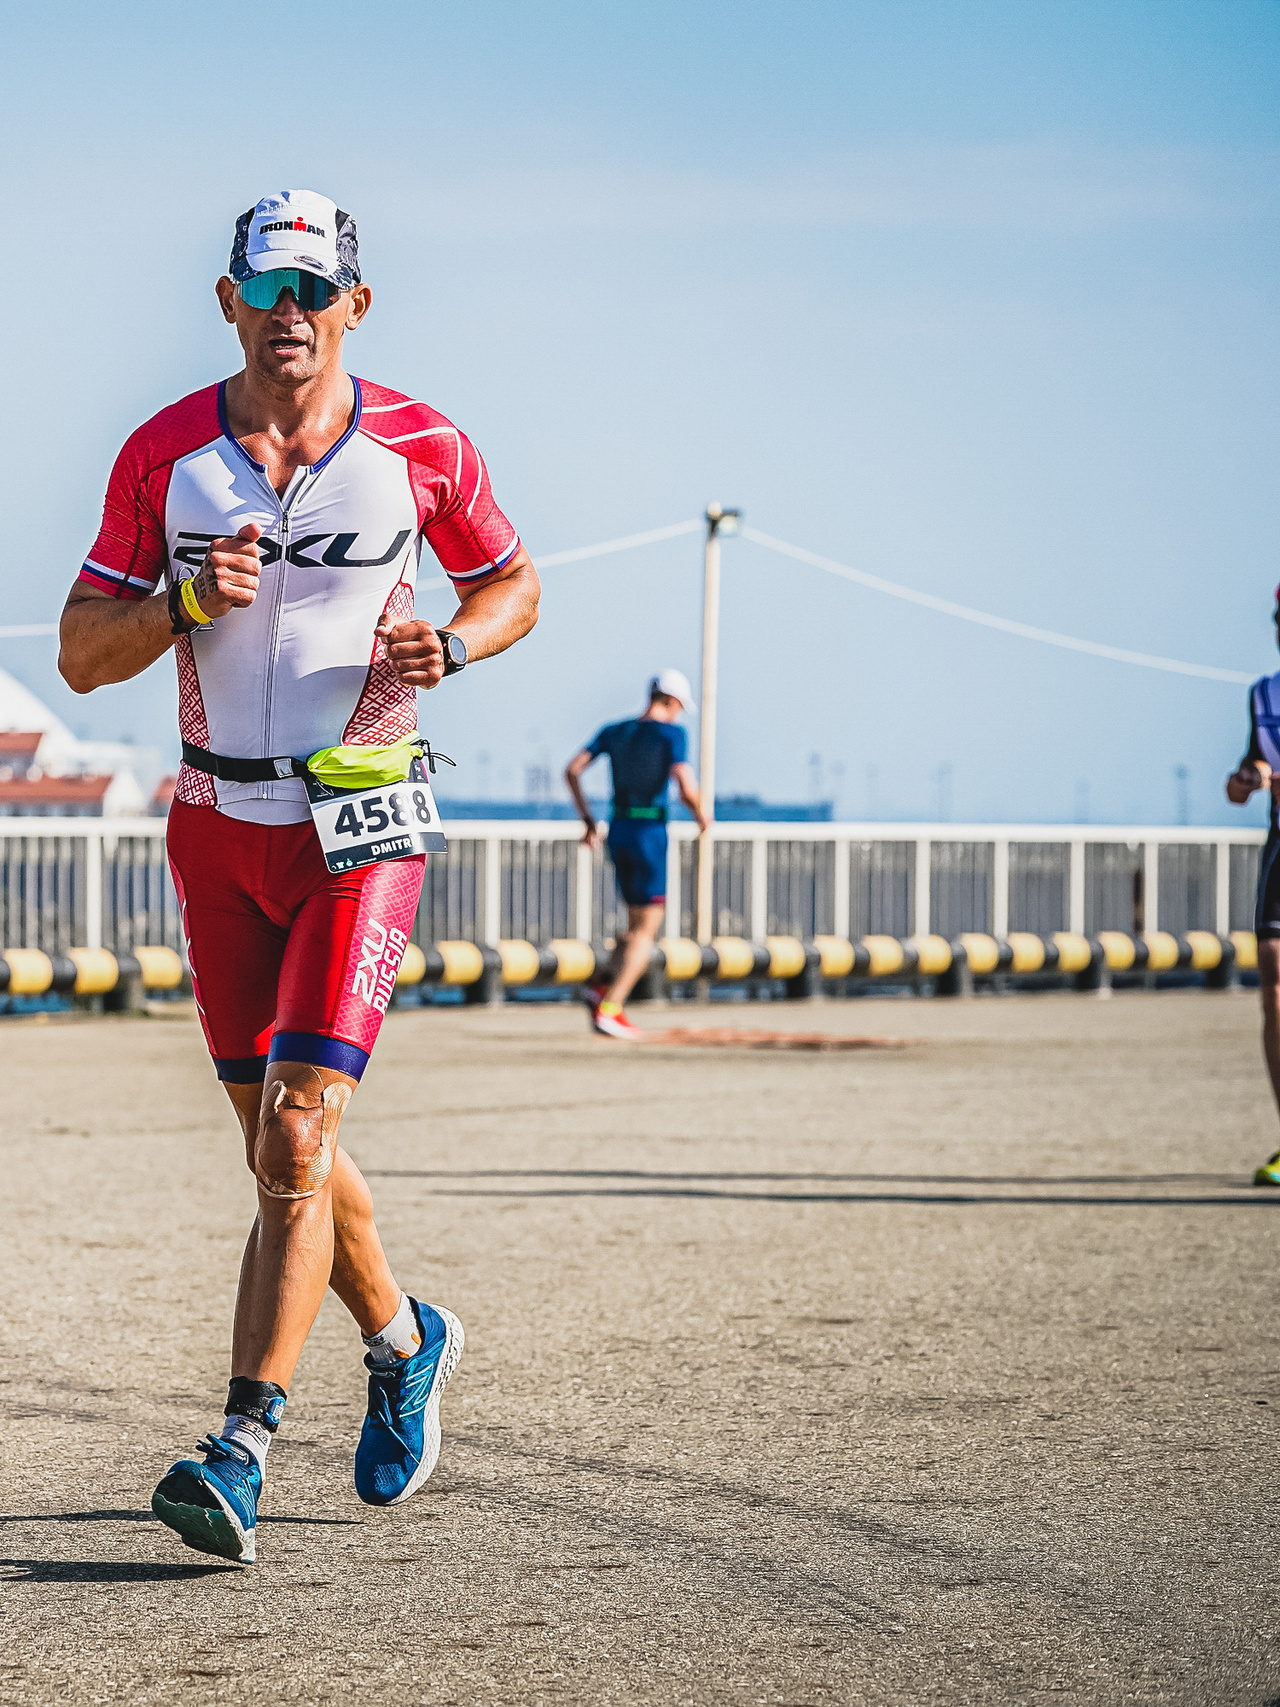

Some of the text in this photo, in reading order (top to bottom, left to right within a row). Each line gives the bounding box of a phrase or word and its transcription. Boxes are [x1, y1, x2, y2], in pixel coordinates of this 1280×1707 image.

[260, 217, 326, 238] IRONMAN
[334, 790, 431, 838] 4588
[352, 917, 388, 1006] 2XU
